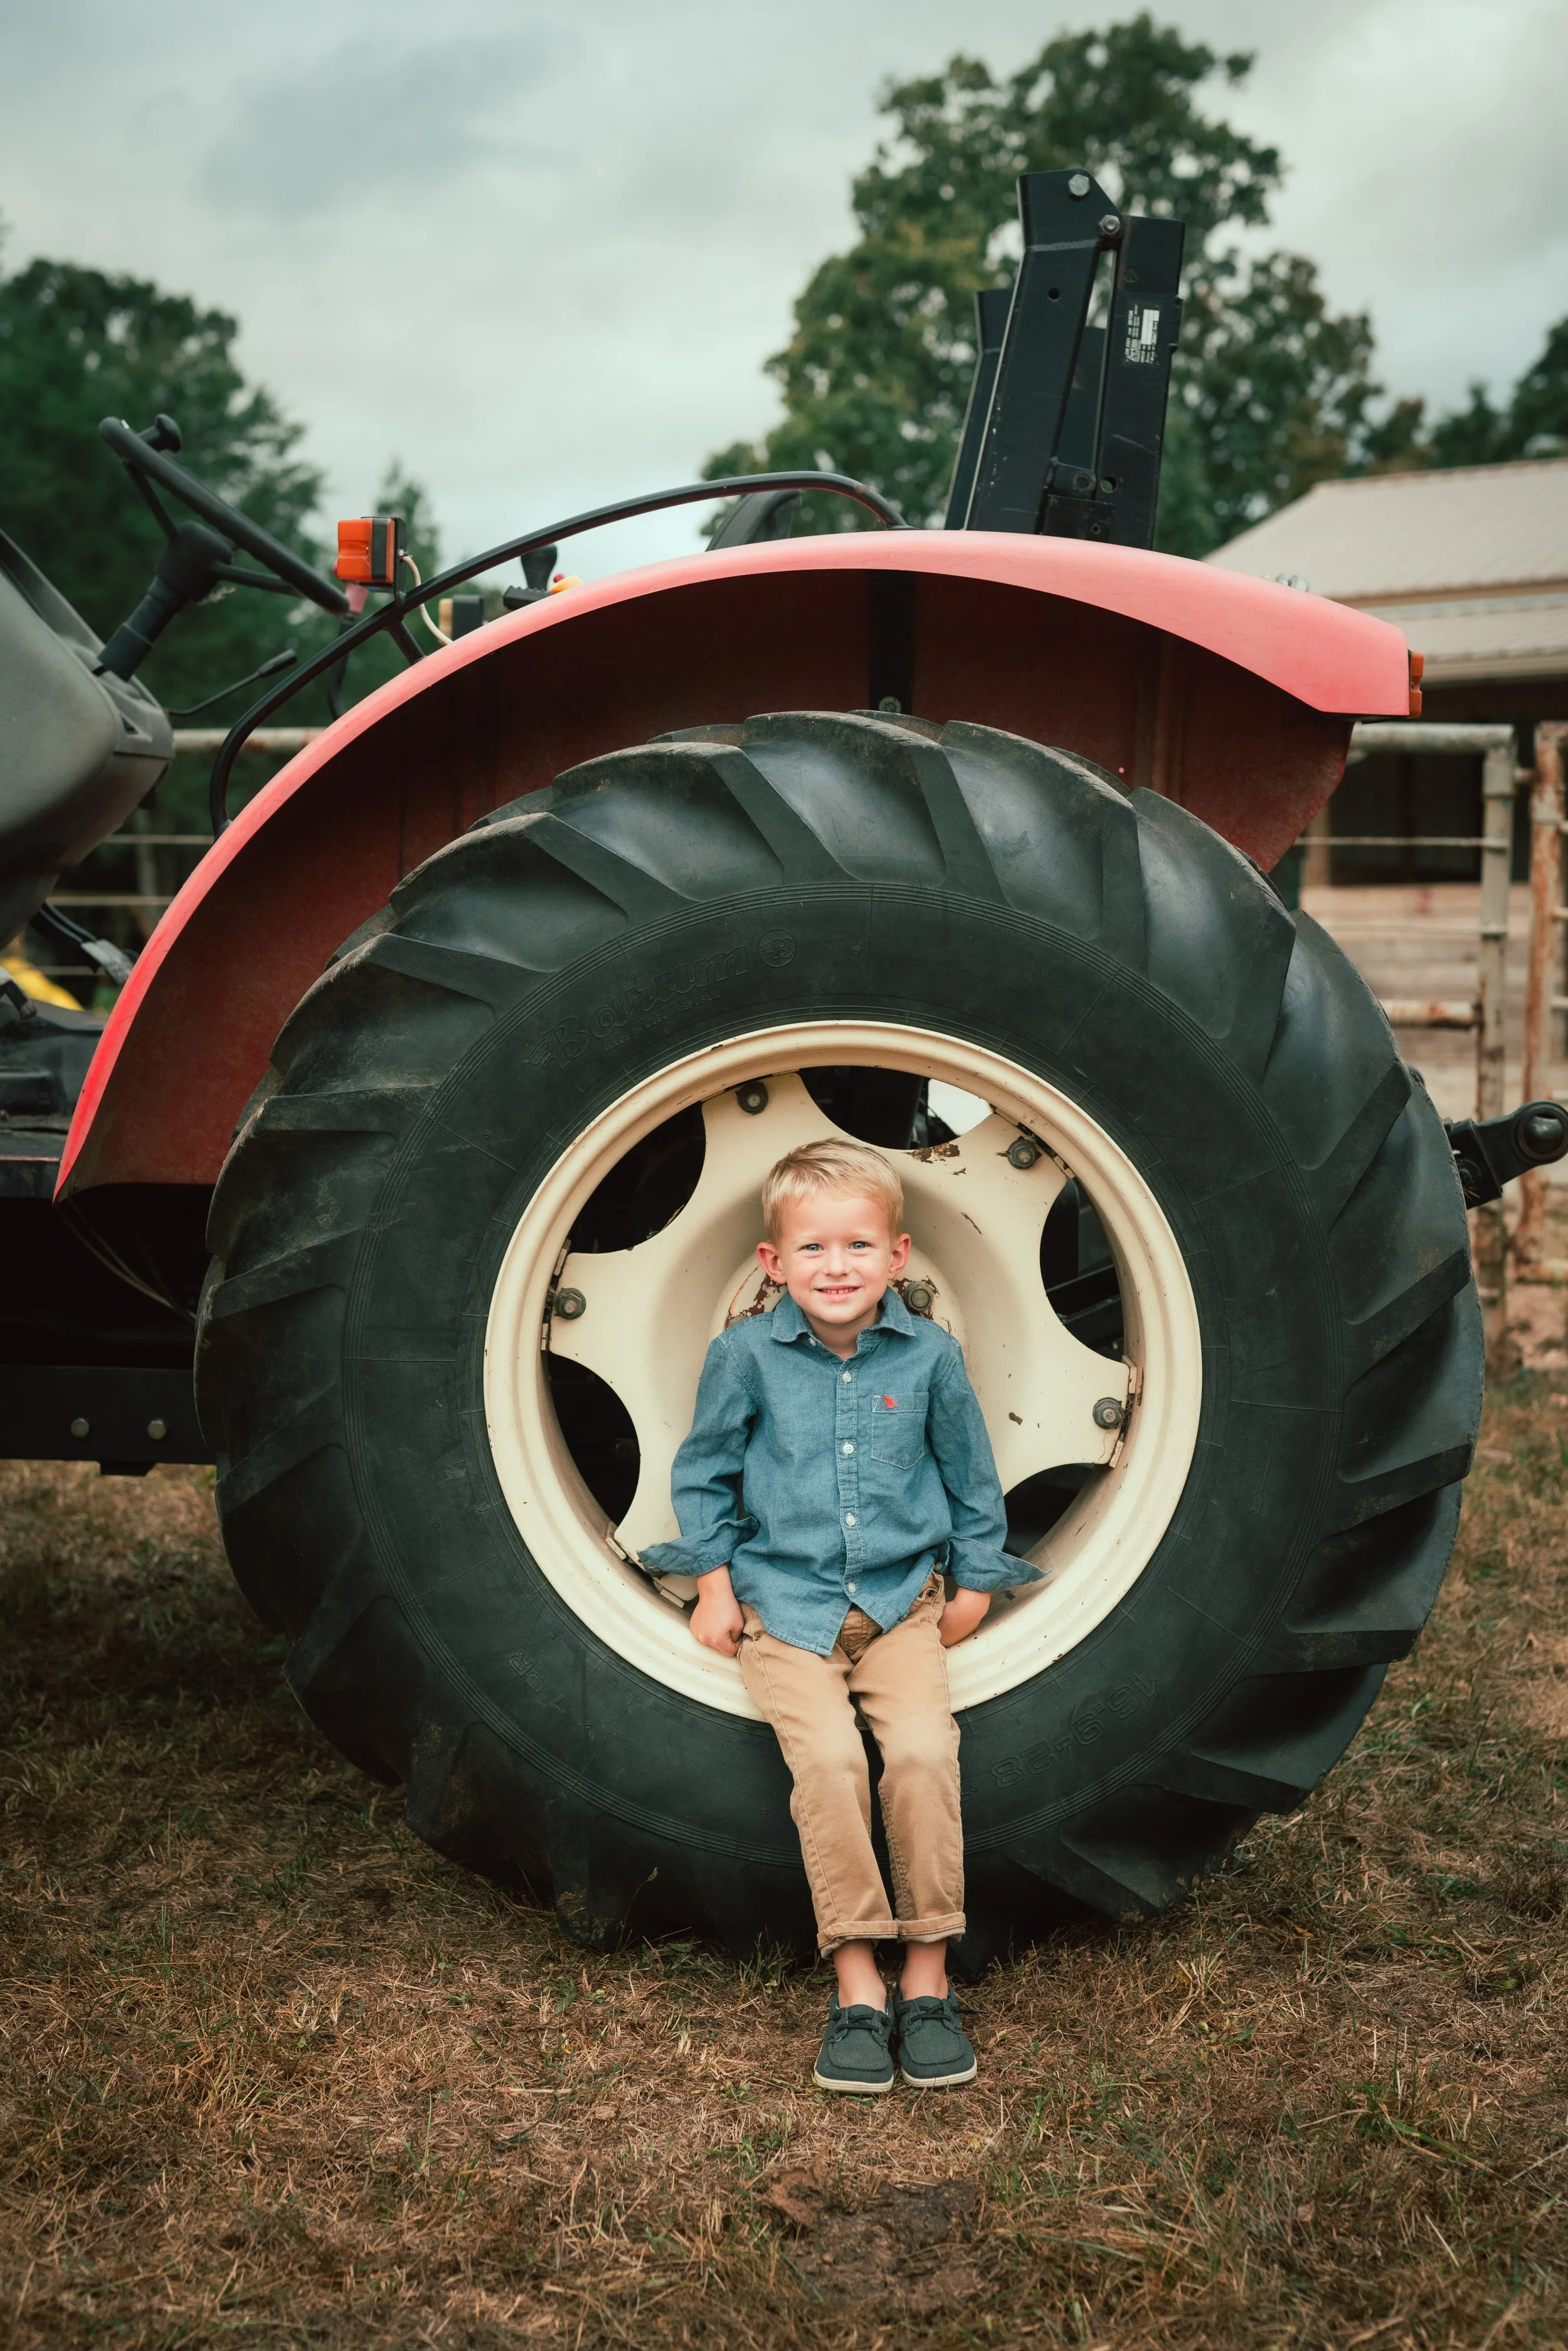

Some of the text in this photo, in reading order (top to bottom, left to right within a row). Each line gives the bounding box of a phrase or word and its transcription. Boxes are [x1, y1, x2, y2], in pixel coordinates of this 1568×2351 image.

[539, 945, 750, 1070] Barum
[604, 1032, 632, 1054] MADE
[632, 1026, 643, 1036] IN
[989, 1674, 1158, 1790] 16.9-28
